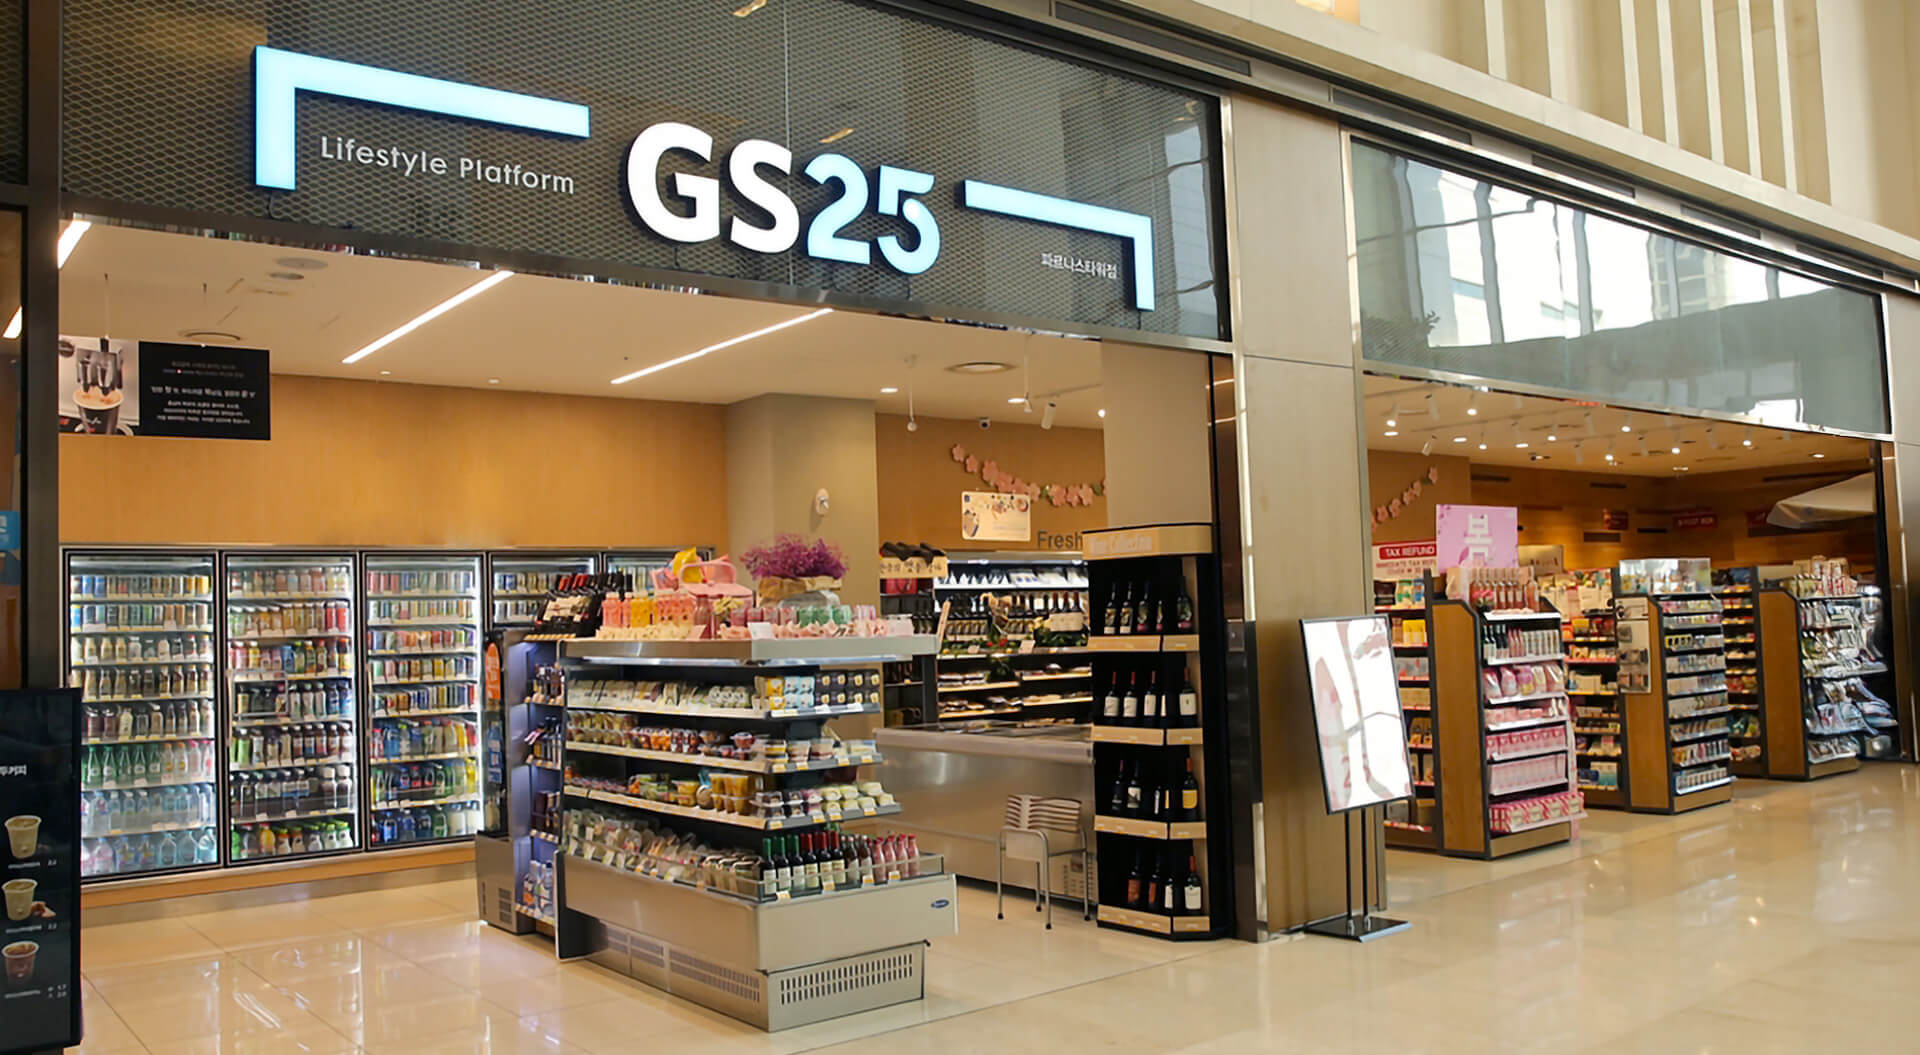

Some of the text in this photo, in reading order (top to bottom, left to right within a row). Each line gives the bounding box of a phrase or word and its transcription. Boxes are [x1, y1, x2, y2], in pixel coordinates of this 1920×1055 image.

[321, 136, 575, 194] Lifestyle Platform
[627, 122, 941, 274] GS25
[1041, 252, 1117, 279] 파르나스타워점
[1037, 530, 1083, 549] Fresh
[1384, 545, 1435, 557] TAX REFUND
